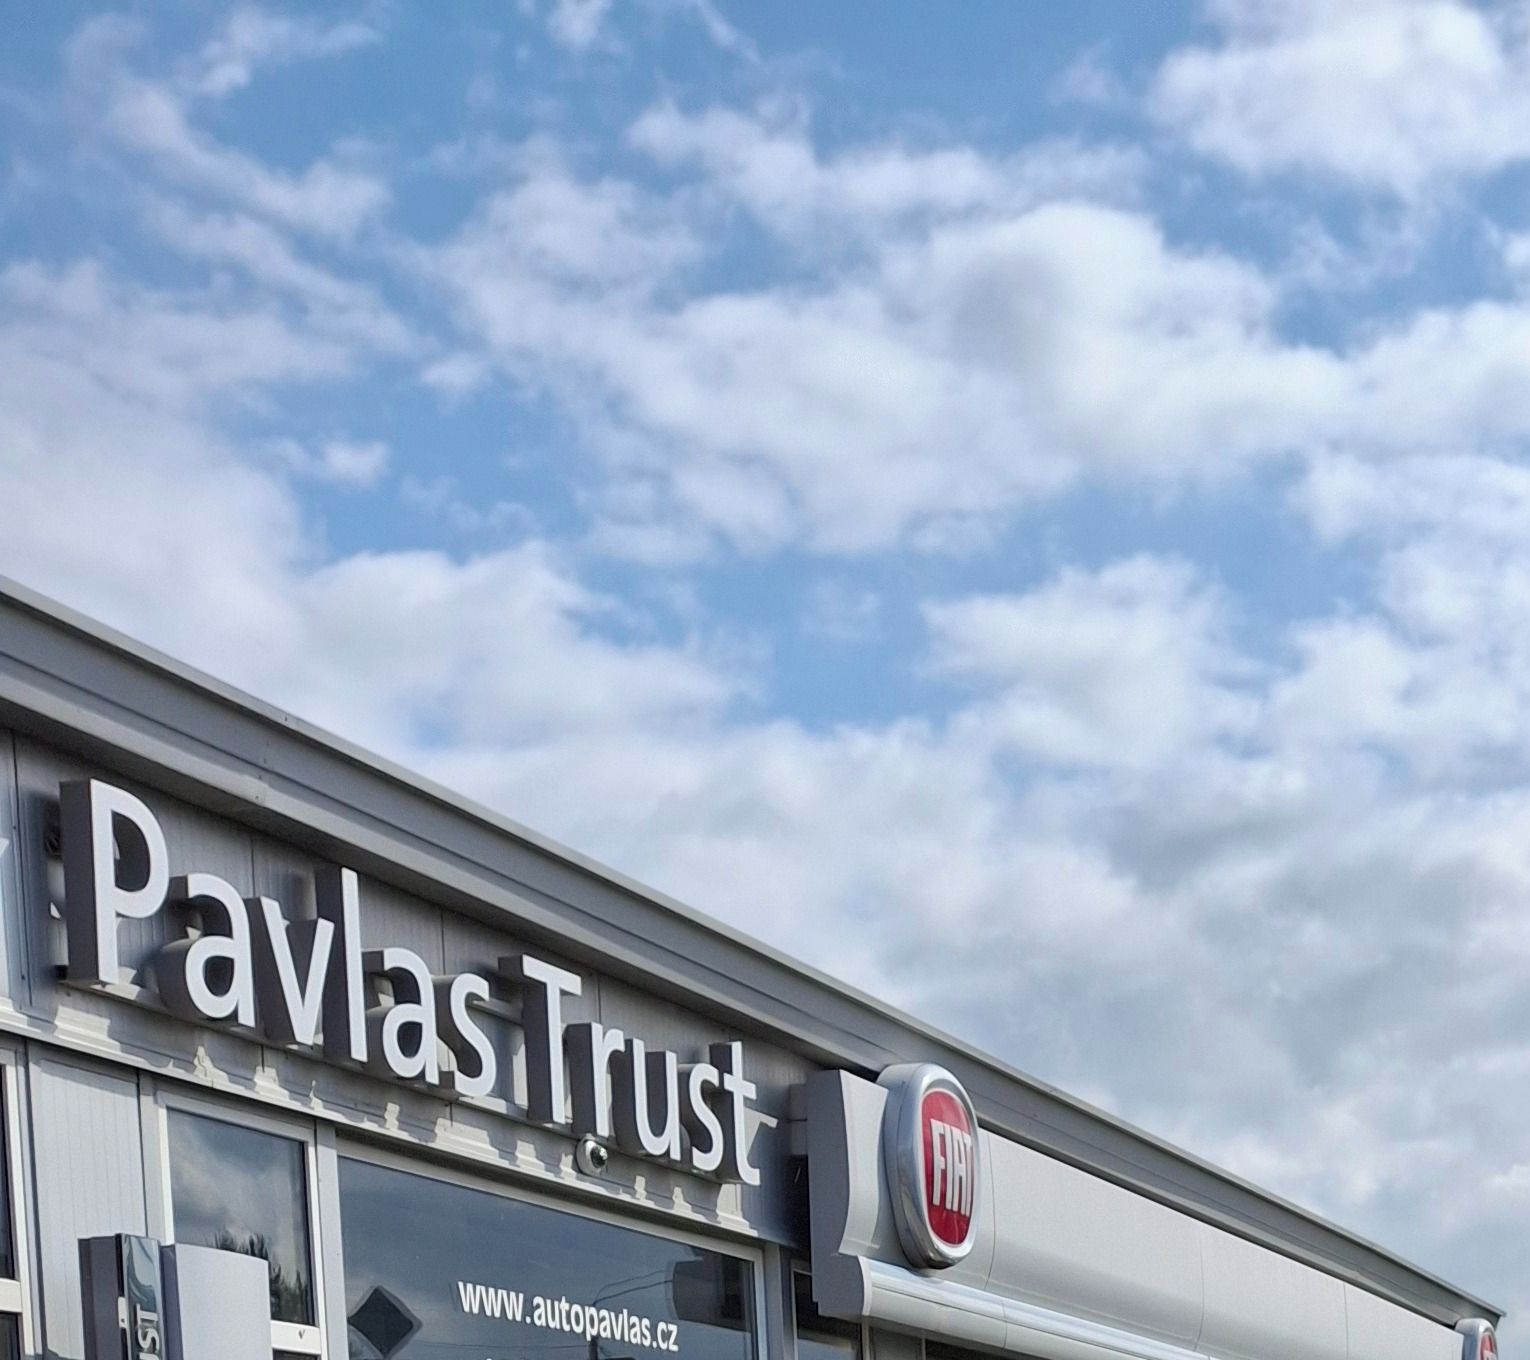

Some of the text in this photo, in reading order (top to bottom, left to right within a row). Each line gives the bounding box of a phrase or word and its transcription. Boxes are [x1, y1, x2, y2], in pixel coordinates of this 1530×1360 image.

[89, 778, 761, 1187] Pavlas Trust
[929, 1118, 975, 1218] FIAT
[457, 1280, 679, 1352] www.autopavlas.cz
